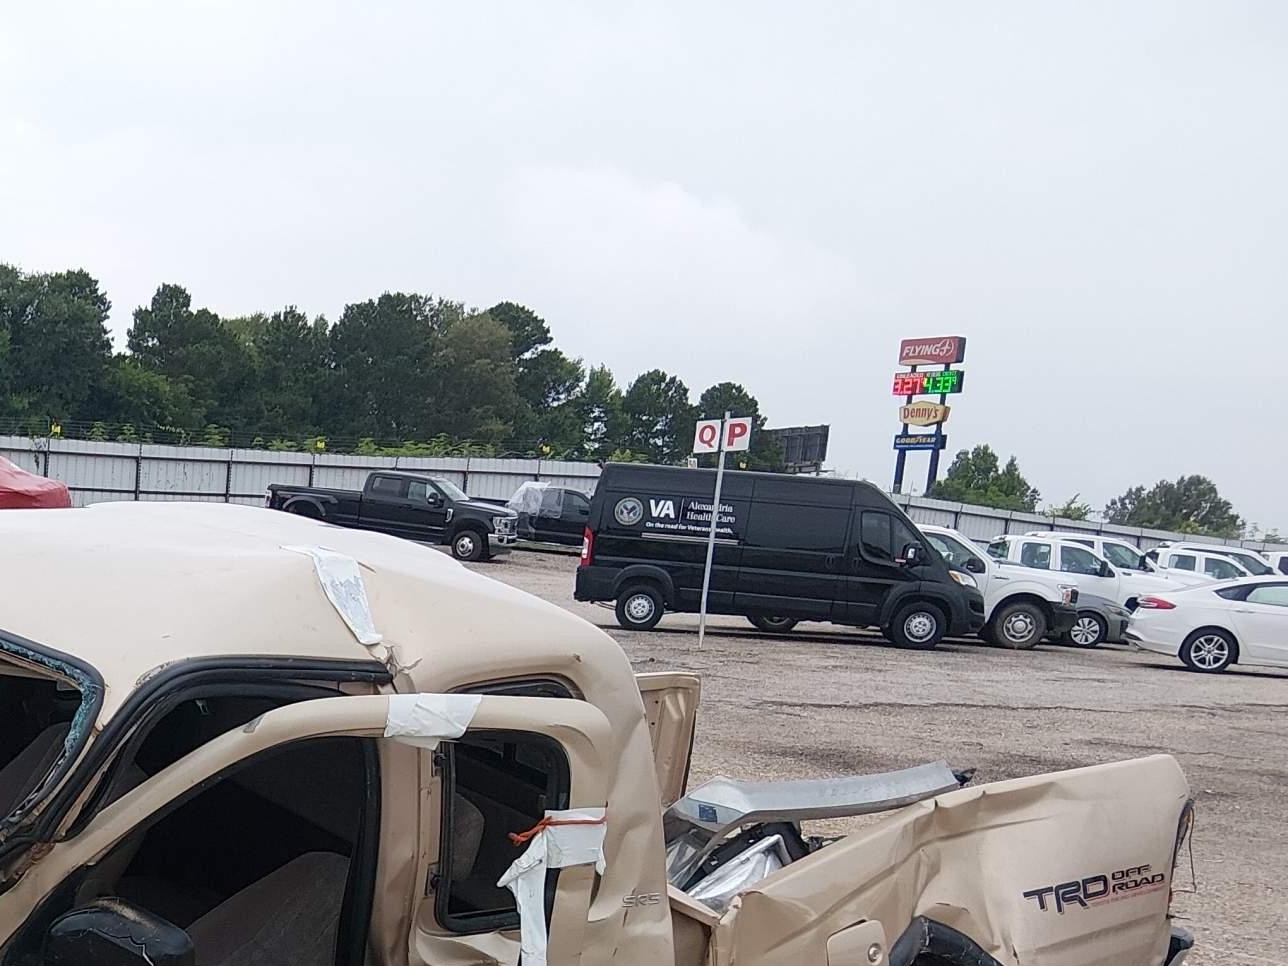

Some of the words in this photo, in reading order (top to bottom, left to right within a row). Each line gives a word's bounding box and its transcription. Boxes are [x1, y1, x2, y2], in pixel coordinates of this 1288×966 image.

[903, 344, 940, 357] FLYING
[903, 408, 939, 420] Denny's
[699, 424, 716, 448] Q
[727, 422, 748, 447] P
[649, 499, 675, 519] VA
[716, 513, 736, 523] Care
[1111, 863, 1153, 881] OFF
[1112, 872, 1165, 894] ROAD
[1022, 873, 1110, 915] TRD
